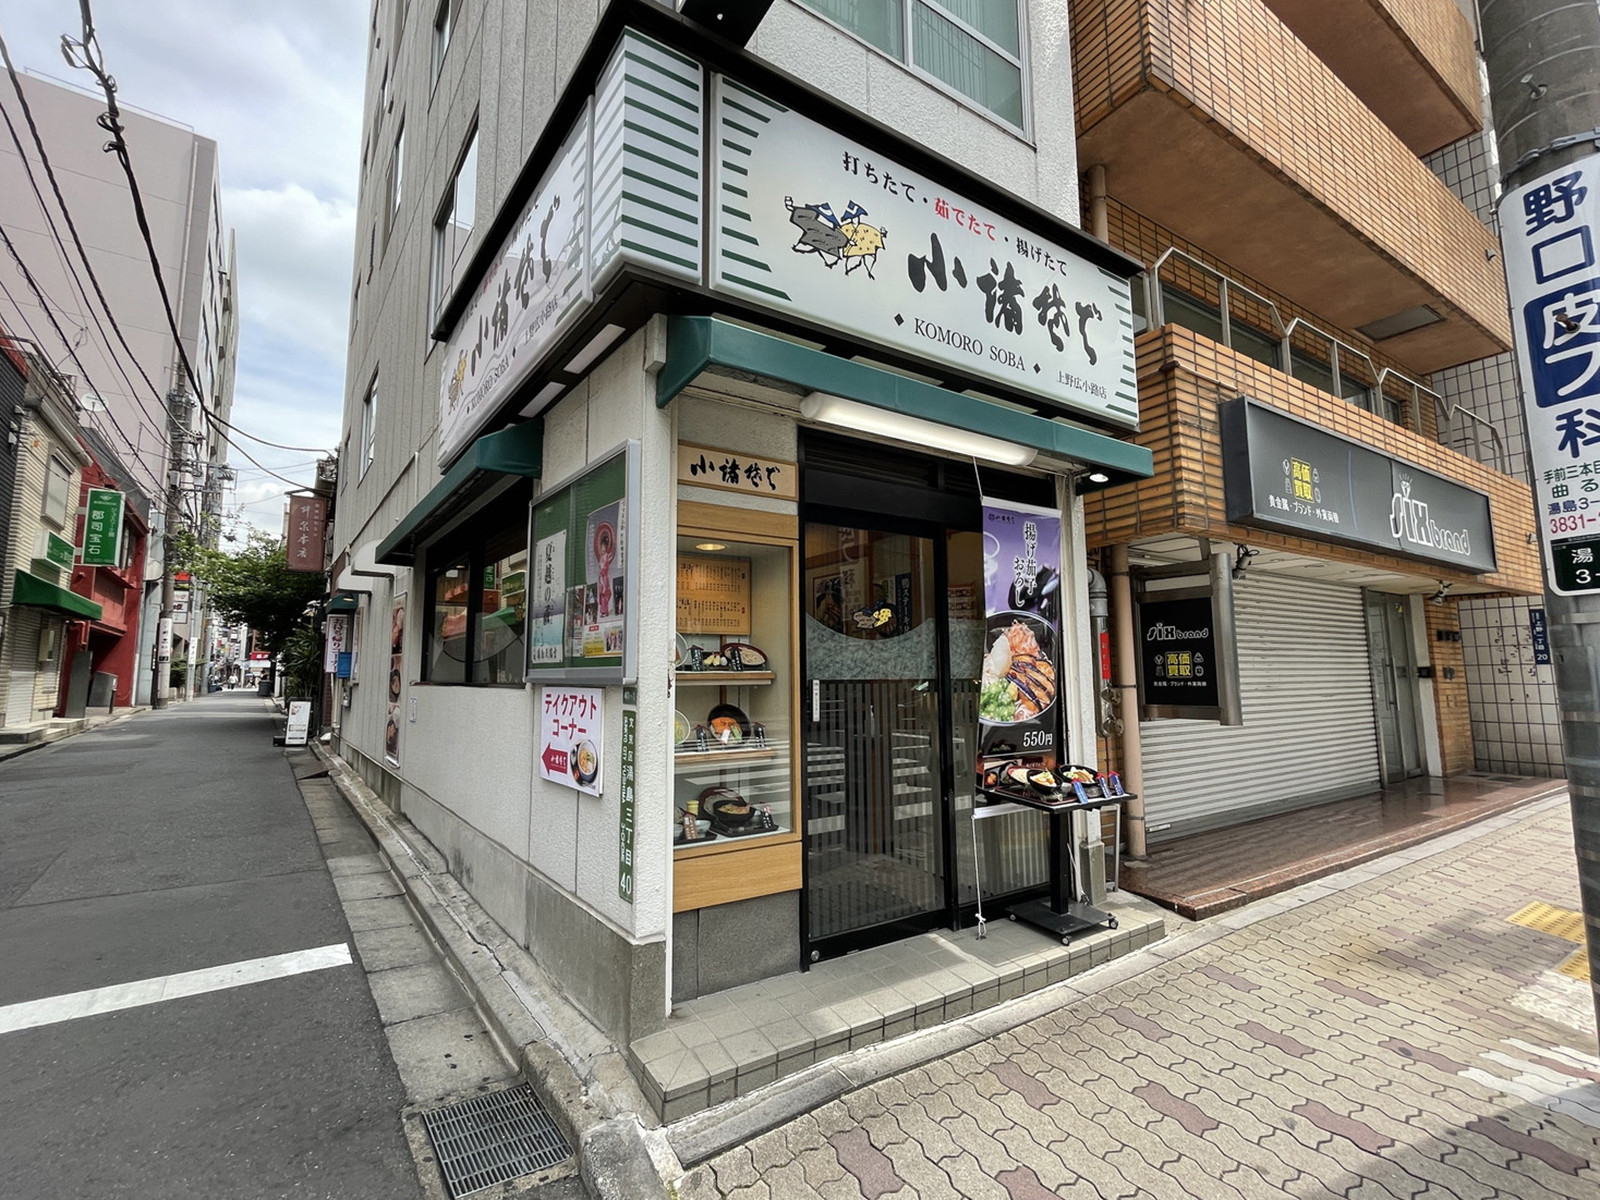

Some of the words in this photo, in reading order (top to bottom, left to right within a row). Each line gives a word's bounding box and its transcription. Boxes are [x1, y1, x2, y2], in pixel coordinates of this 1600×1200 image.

[914, 317, 983, 356] KOMORO
[989, 345, 1026, 372] SOBA
[1056, 370, 1108, 400] 上野広小路店
[1292, 461, 1310, 482] 高価
[1550, 512, 1600, 534] 3831-
[1430, 520, 1471, 556] brand
[1025, 522, 1037, 595] 揚げ茄子
[1014, 556, 1025, 607] おろし
[1176, 628, 1209, 639] brand
[1167, 653, 1190, 664] 高価
[1168, 665, 1191, 676] 買取
[545, 693, 597, 719] テイクアウト
[552, 718, 586, 740] コーナー
[1023, 731, 1053, 748] 550円
[620, 873, 631, 895] 40
